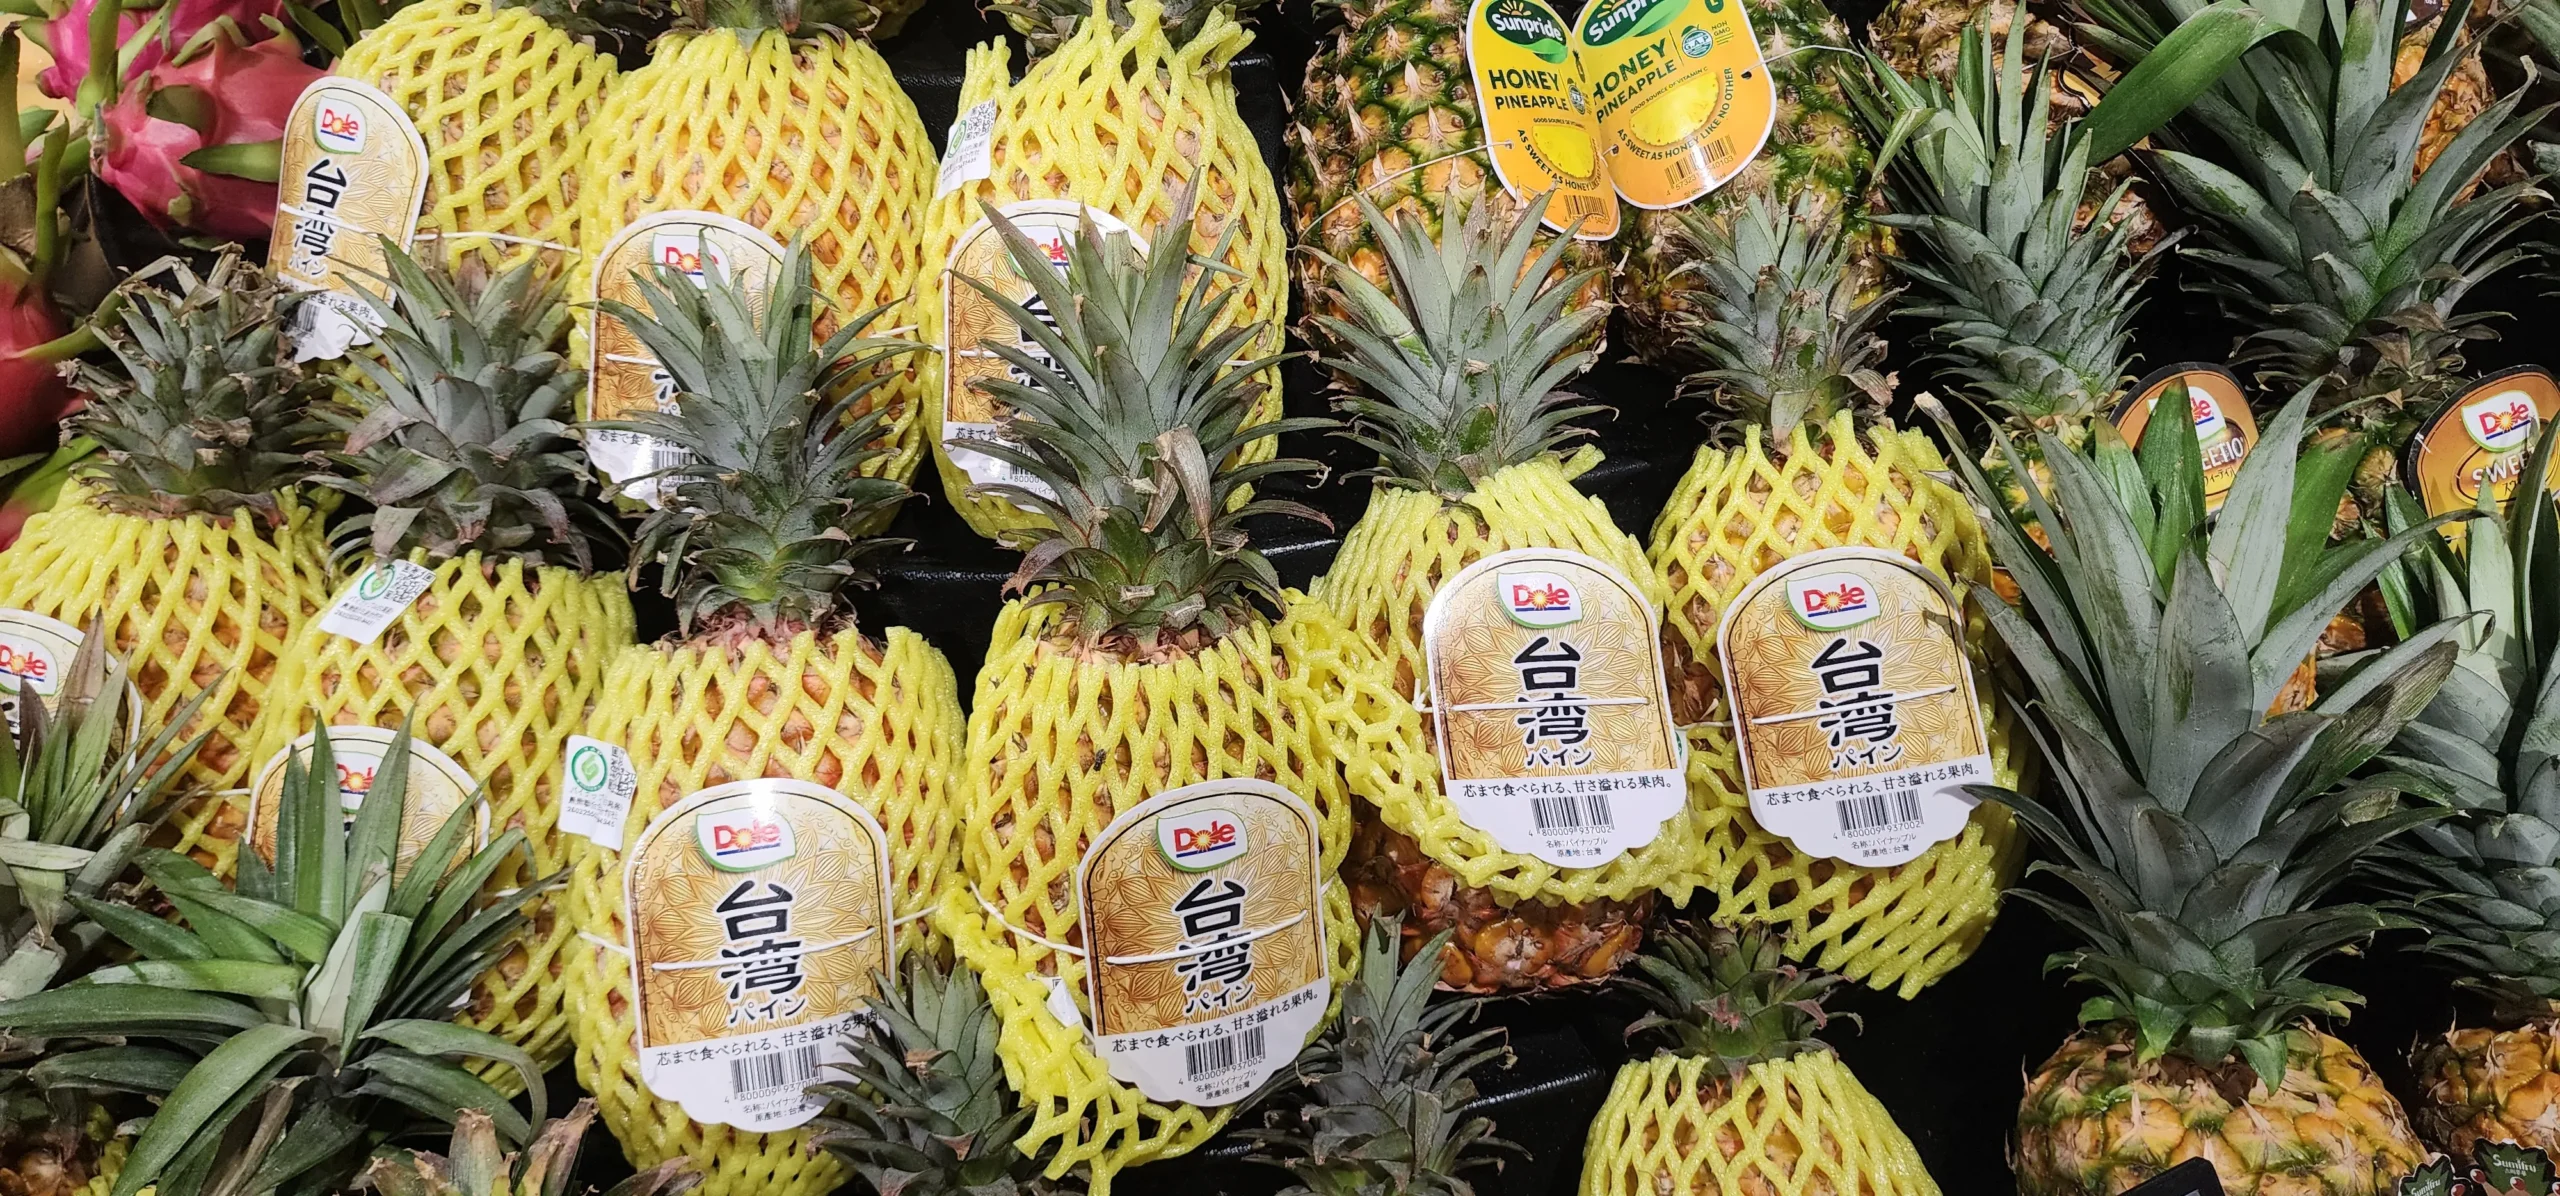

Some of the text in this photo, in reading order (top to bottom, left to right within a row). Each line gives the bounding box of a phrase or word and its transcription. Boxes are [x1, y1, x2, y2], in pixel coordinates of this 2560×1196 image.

[1491, 13, 1563, 42] Sunpride
[1713, 26, 1731, 37] GMO
[1488, 68, 1560, 92] HONEY
[1593, 38, 1666, 102] HONEY
[1495, 94, 1569, 112] PINEAPPLE
[1596, 59, 1677, 124] PINEAPPLE
[1630, 101, 1646, 114] GOOD
[1646, 86, 1668, 103] SOURCE
[1677, 69, 1703, 85] VITAMIN
[321, 108, 359, 136] Dole
[1617, 67, 1733, 161] AS SWEET AS HONEY LIKE NO OTHER
[1517, 129, 1529, 143] AS
[1525, 144, 1552, 175] SWEET
[1551, 173, 1563, 184] AS
[1565, 179, 1590, 192] HONEY
[295, 159, 347, 256] 台湾
[289, 256, 326, 276] パイン
[2478, 402, 2529, 435] Dole
[1512, 583, 1570, 607] Dole
[1803, 583, 1866, 612] Dole
[1514, 636, 1589, 744] 台湾
[1811, 638, 1898, 747] 台湾
[1527, 747, 1592, 766] パイン
[1832, 745, 1903, 769] パイン
[713, 819, 782, 850] Dole
[1173, 820, 1236, 852] Dole
[1542, 827, 1574, 837] 800009
[1579, 825, 1612, 835] 937002
[1847, 827, 1880, 839] 800009
[1887, 820, 1920, 833] 937002
[716, 880, 803, 999] 台湾
[1175, 878, 1252, 991] 台湾
[730, 997, 806, 1023] パイン
[1185, 983, 1254, 1014] パイン
[1193, 1068, 1227, 1083] 800009
[1231, 1056, 1263, 1072] 937002
[740, 1087, 778, 1102] 800009
[2492, 1153, 2537, 1173] Sumifru
